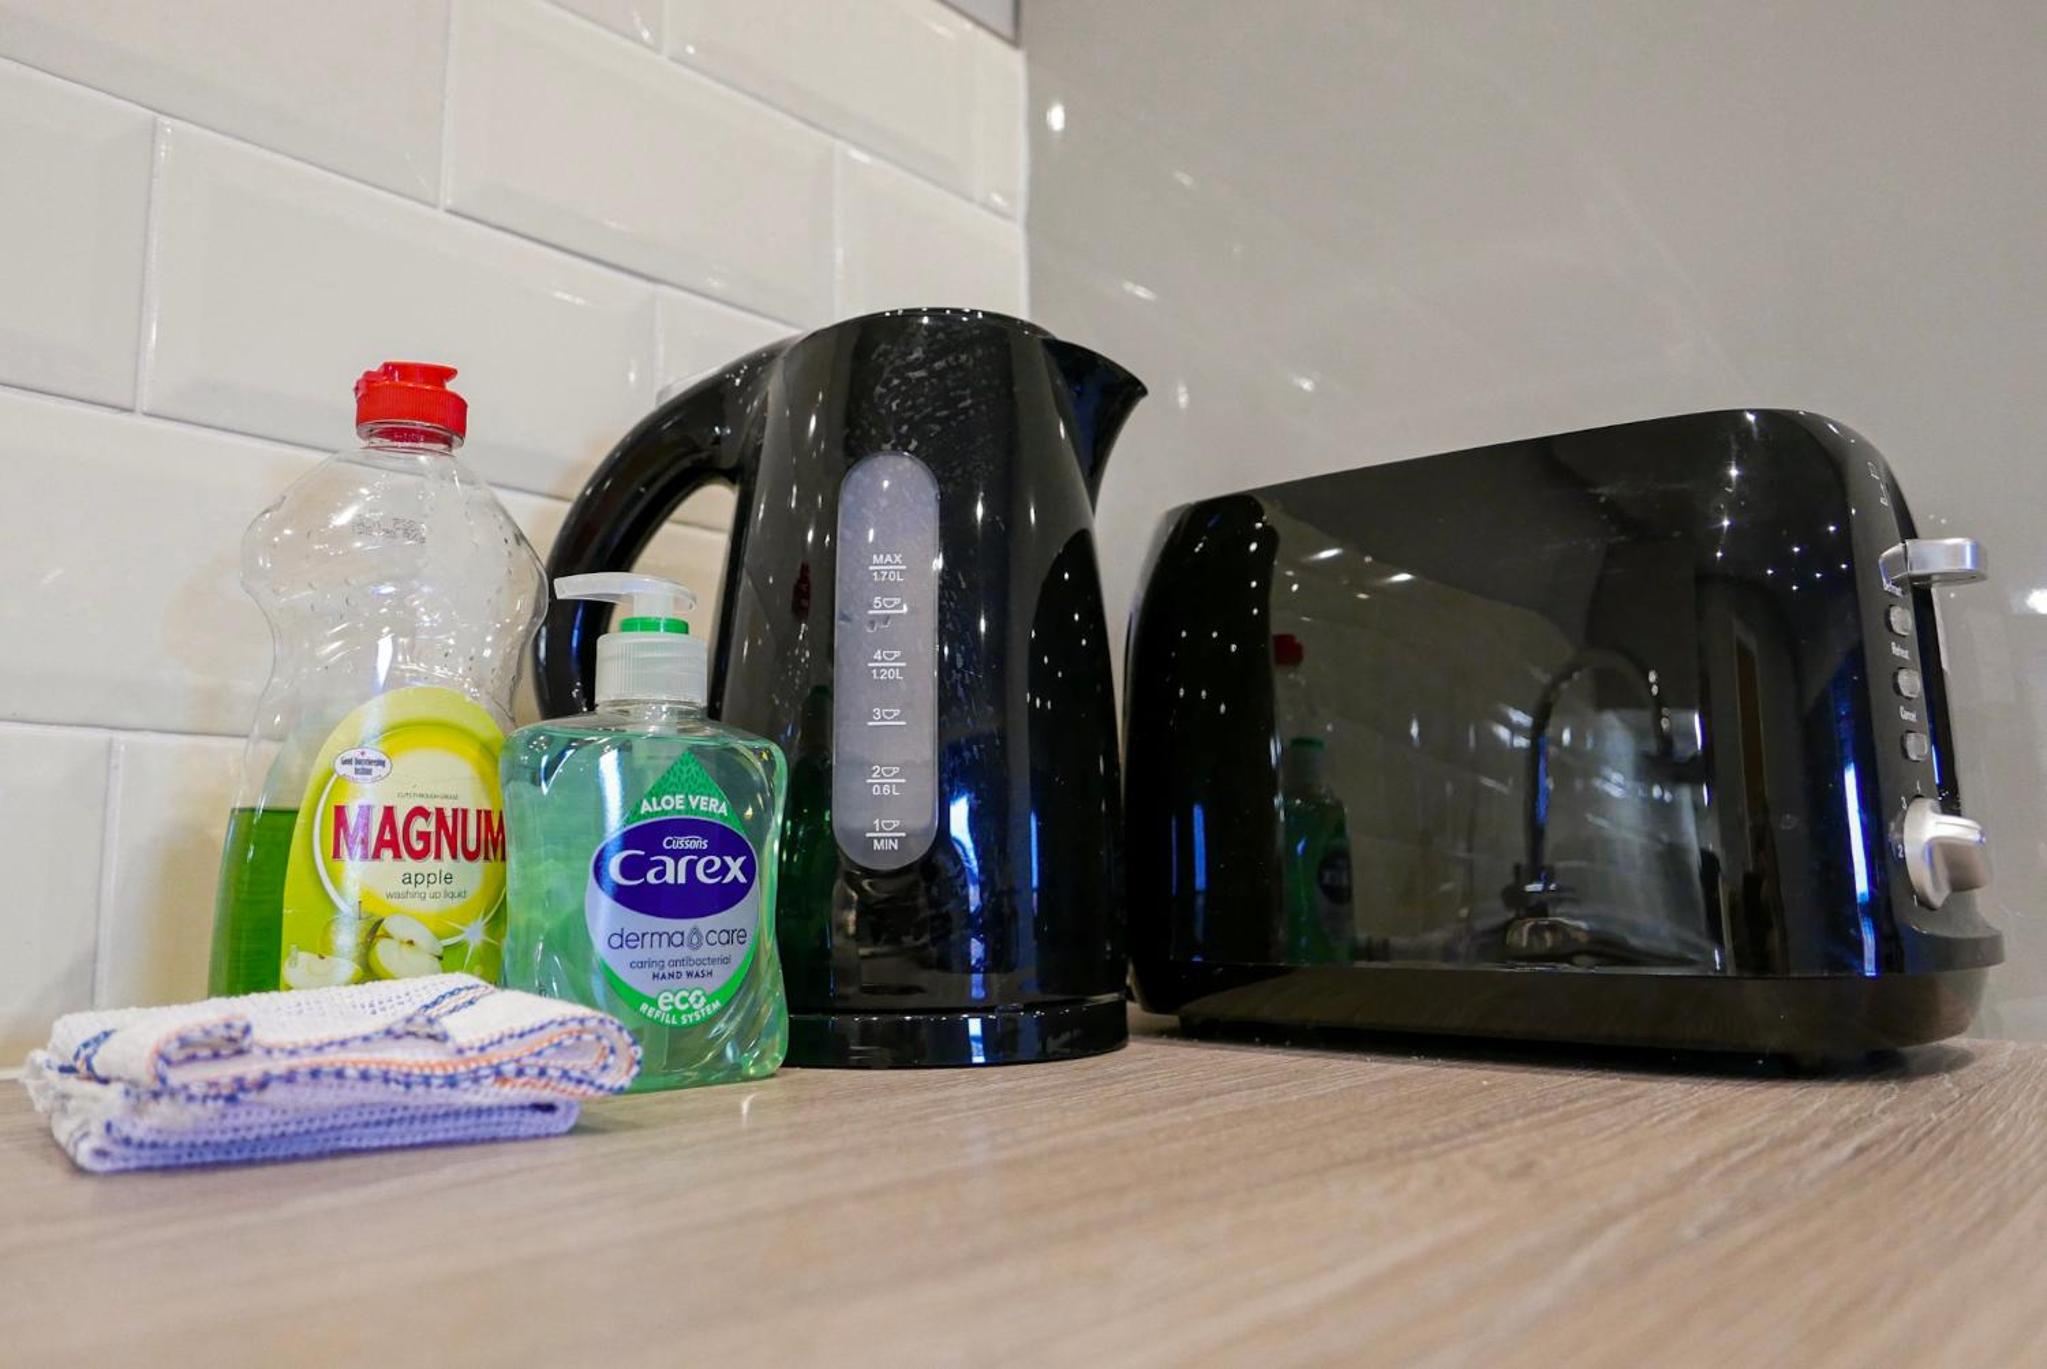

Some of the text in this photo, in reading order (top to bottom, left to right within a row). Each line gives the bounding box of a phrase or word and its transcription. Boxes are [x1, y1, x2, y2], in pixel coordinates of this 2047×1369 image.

[872, 554, 903, 564] MAX
[873, 597, 882, 609] 5
[873, 650, 882, 661] 4
[872, 708, 881, 720] 3
[872, 765, 880, 778] 2
[641, 794, 728, 817] ALOE VERA
[873, 819, 880, 831] 1
[331, 804, 507, 861] MAGNUM
[662, 836, 709, 850] Cussons
[873, 839, 899, 850] MIN
[609, 850, 747, 886] Carex
[401, 869, 454, 889] apple
[385, 889, 427, 900] washing
[607, 927, 748, 950] derma care
[629, 955, 732, 970] caring antibacterial
[652, 969, 714, 981] HAND WASH
[657, 987, 707, 1012] eco
[639, 1000, 722, 1025] REFILL SYSTEM
